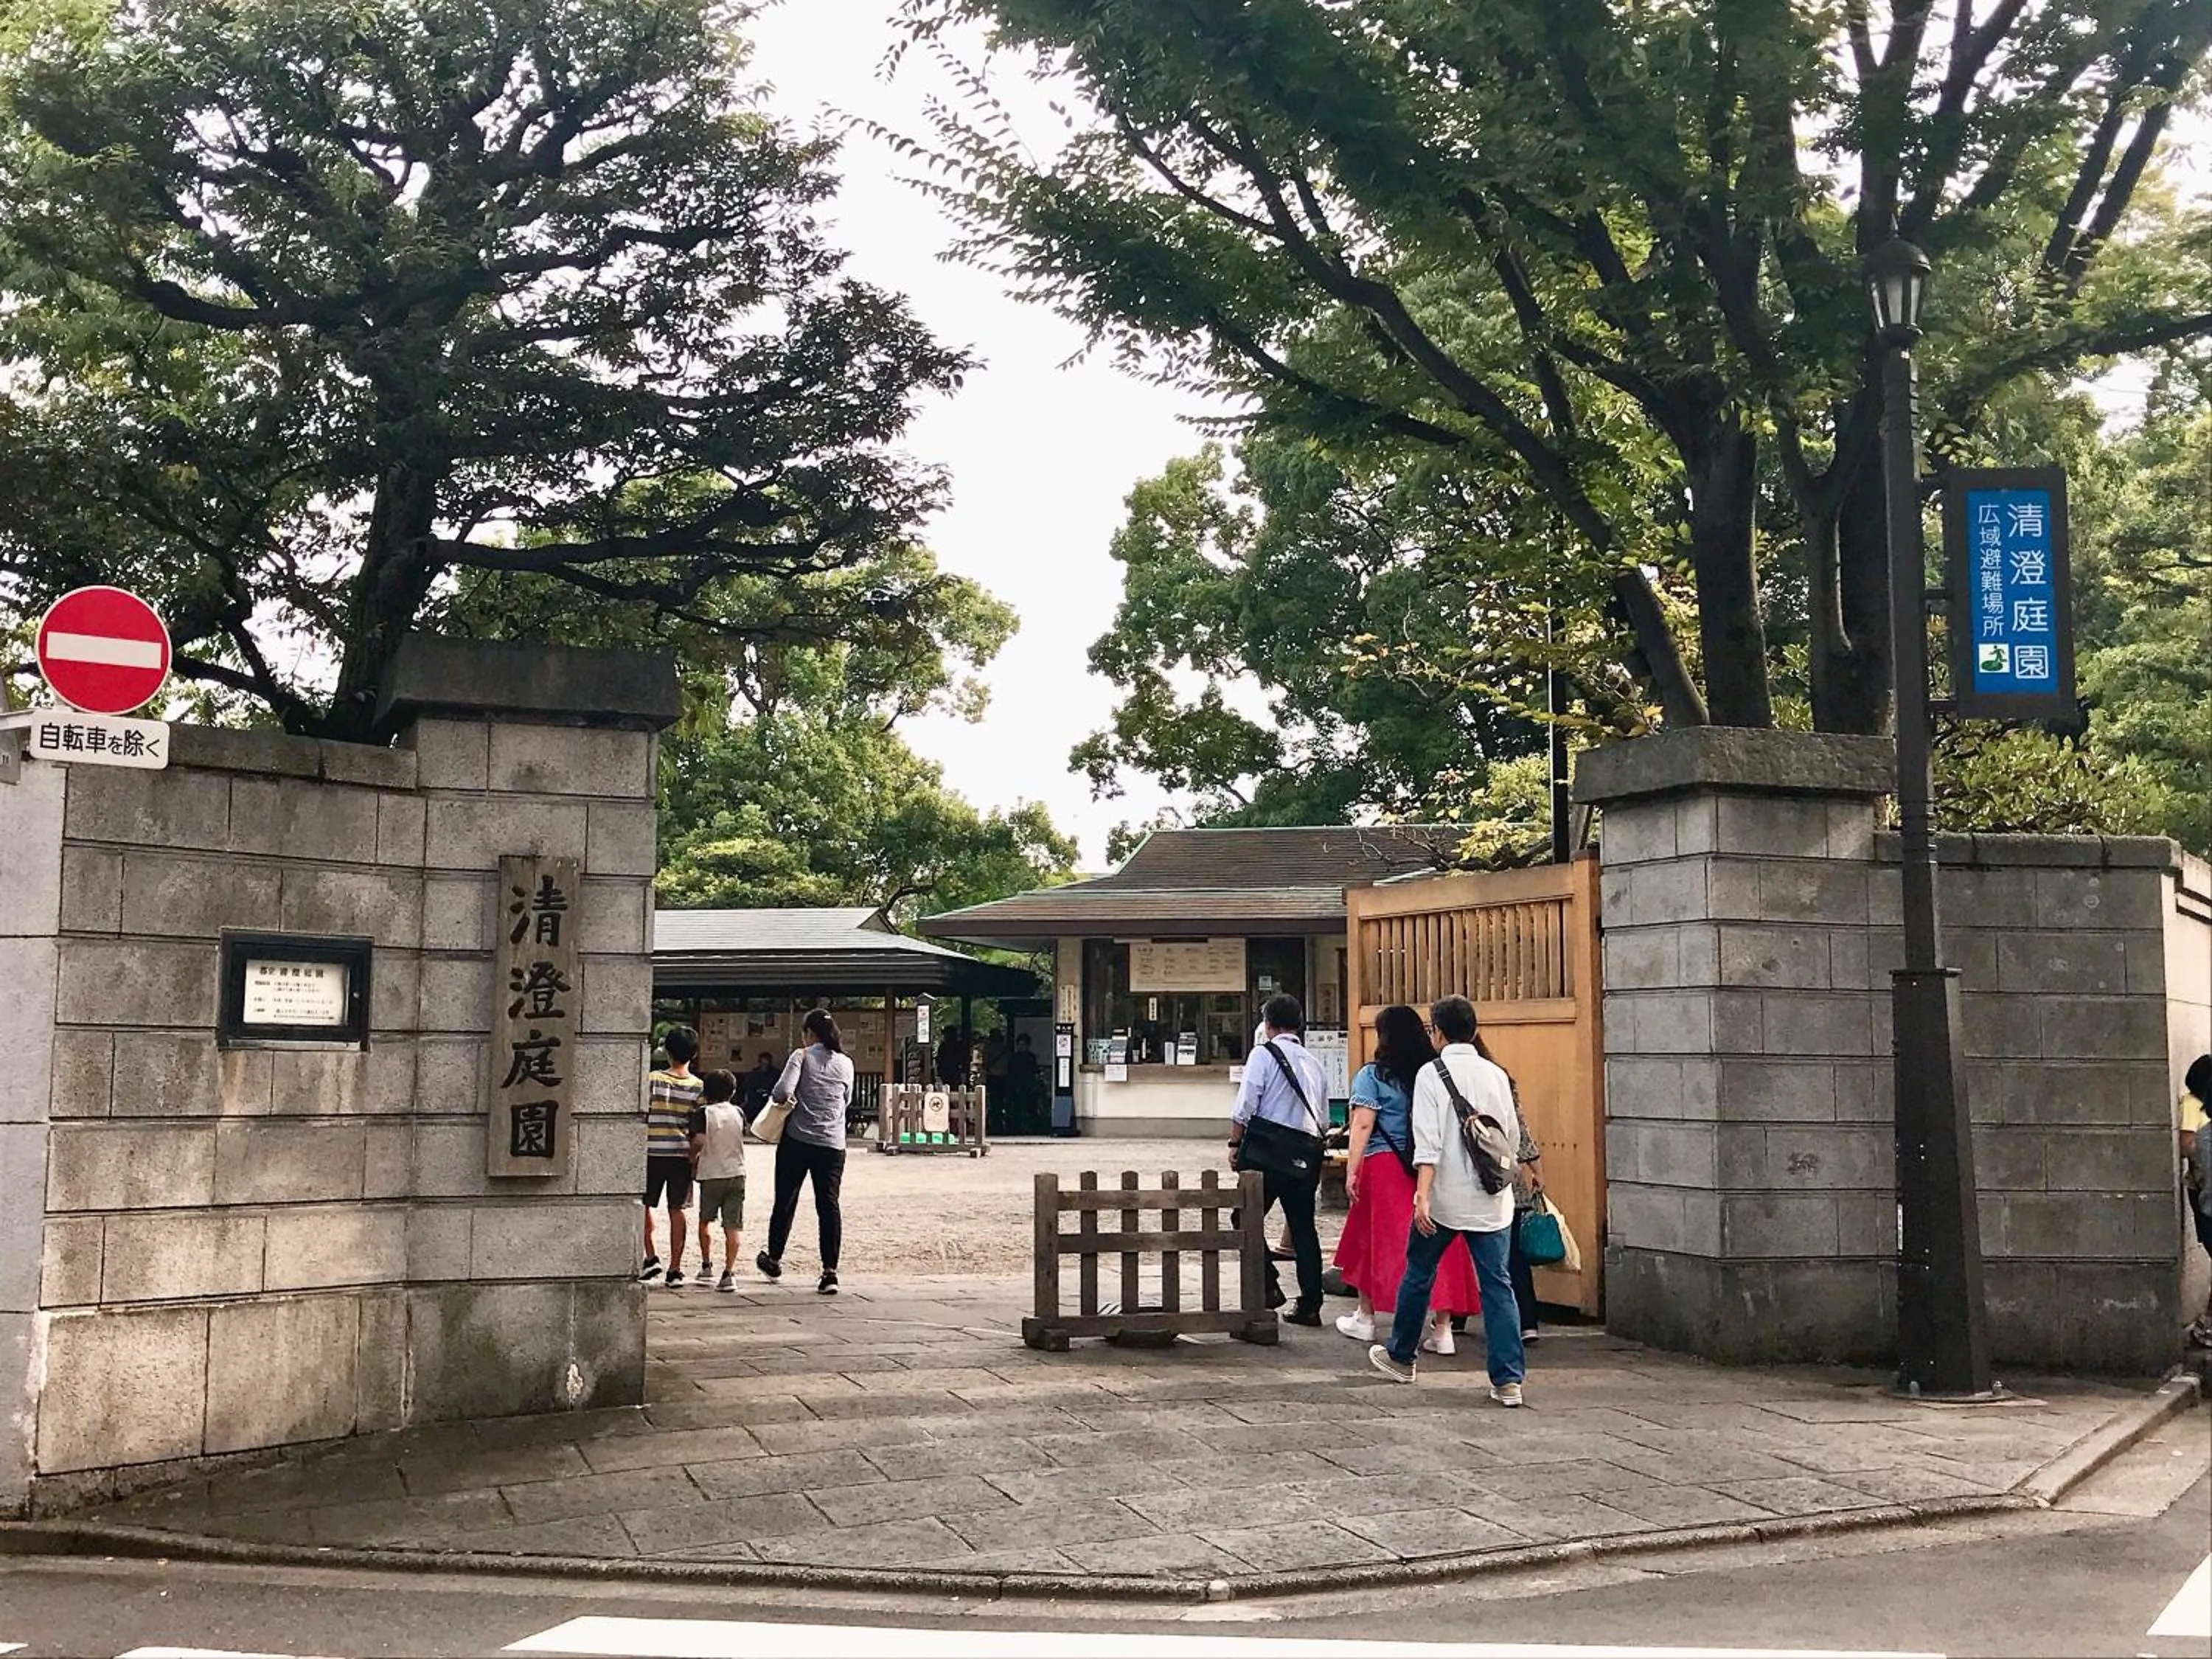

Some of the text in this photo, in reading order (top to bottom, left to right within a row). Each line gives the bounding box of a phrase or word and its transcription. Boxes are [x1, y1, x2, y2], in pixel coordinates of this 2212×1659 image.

[1978, 504, 2004, 637] 広域避難場所
[2006, 502, 2049, 679] 清澄庭園
[39, 722, 160, 758] 自転車を除く
[500, 874, 571, 1158] 清澄庭園
